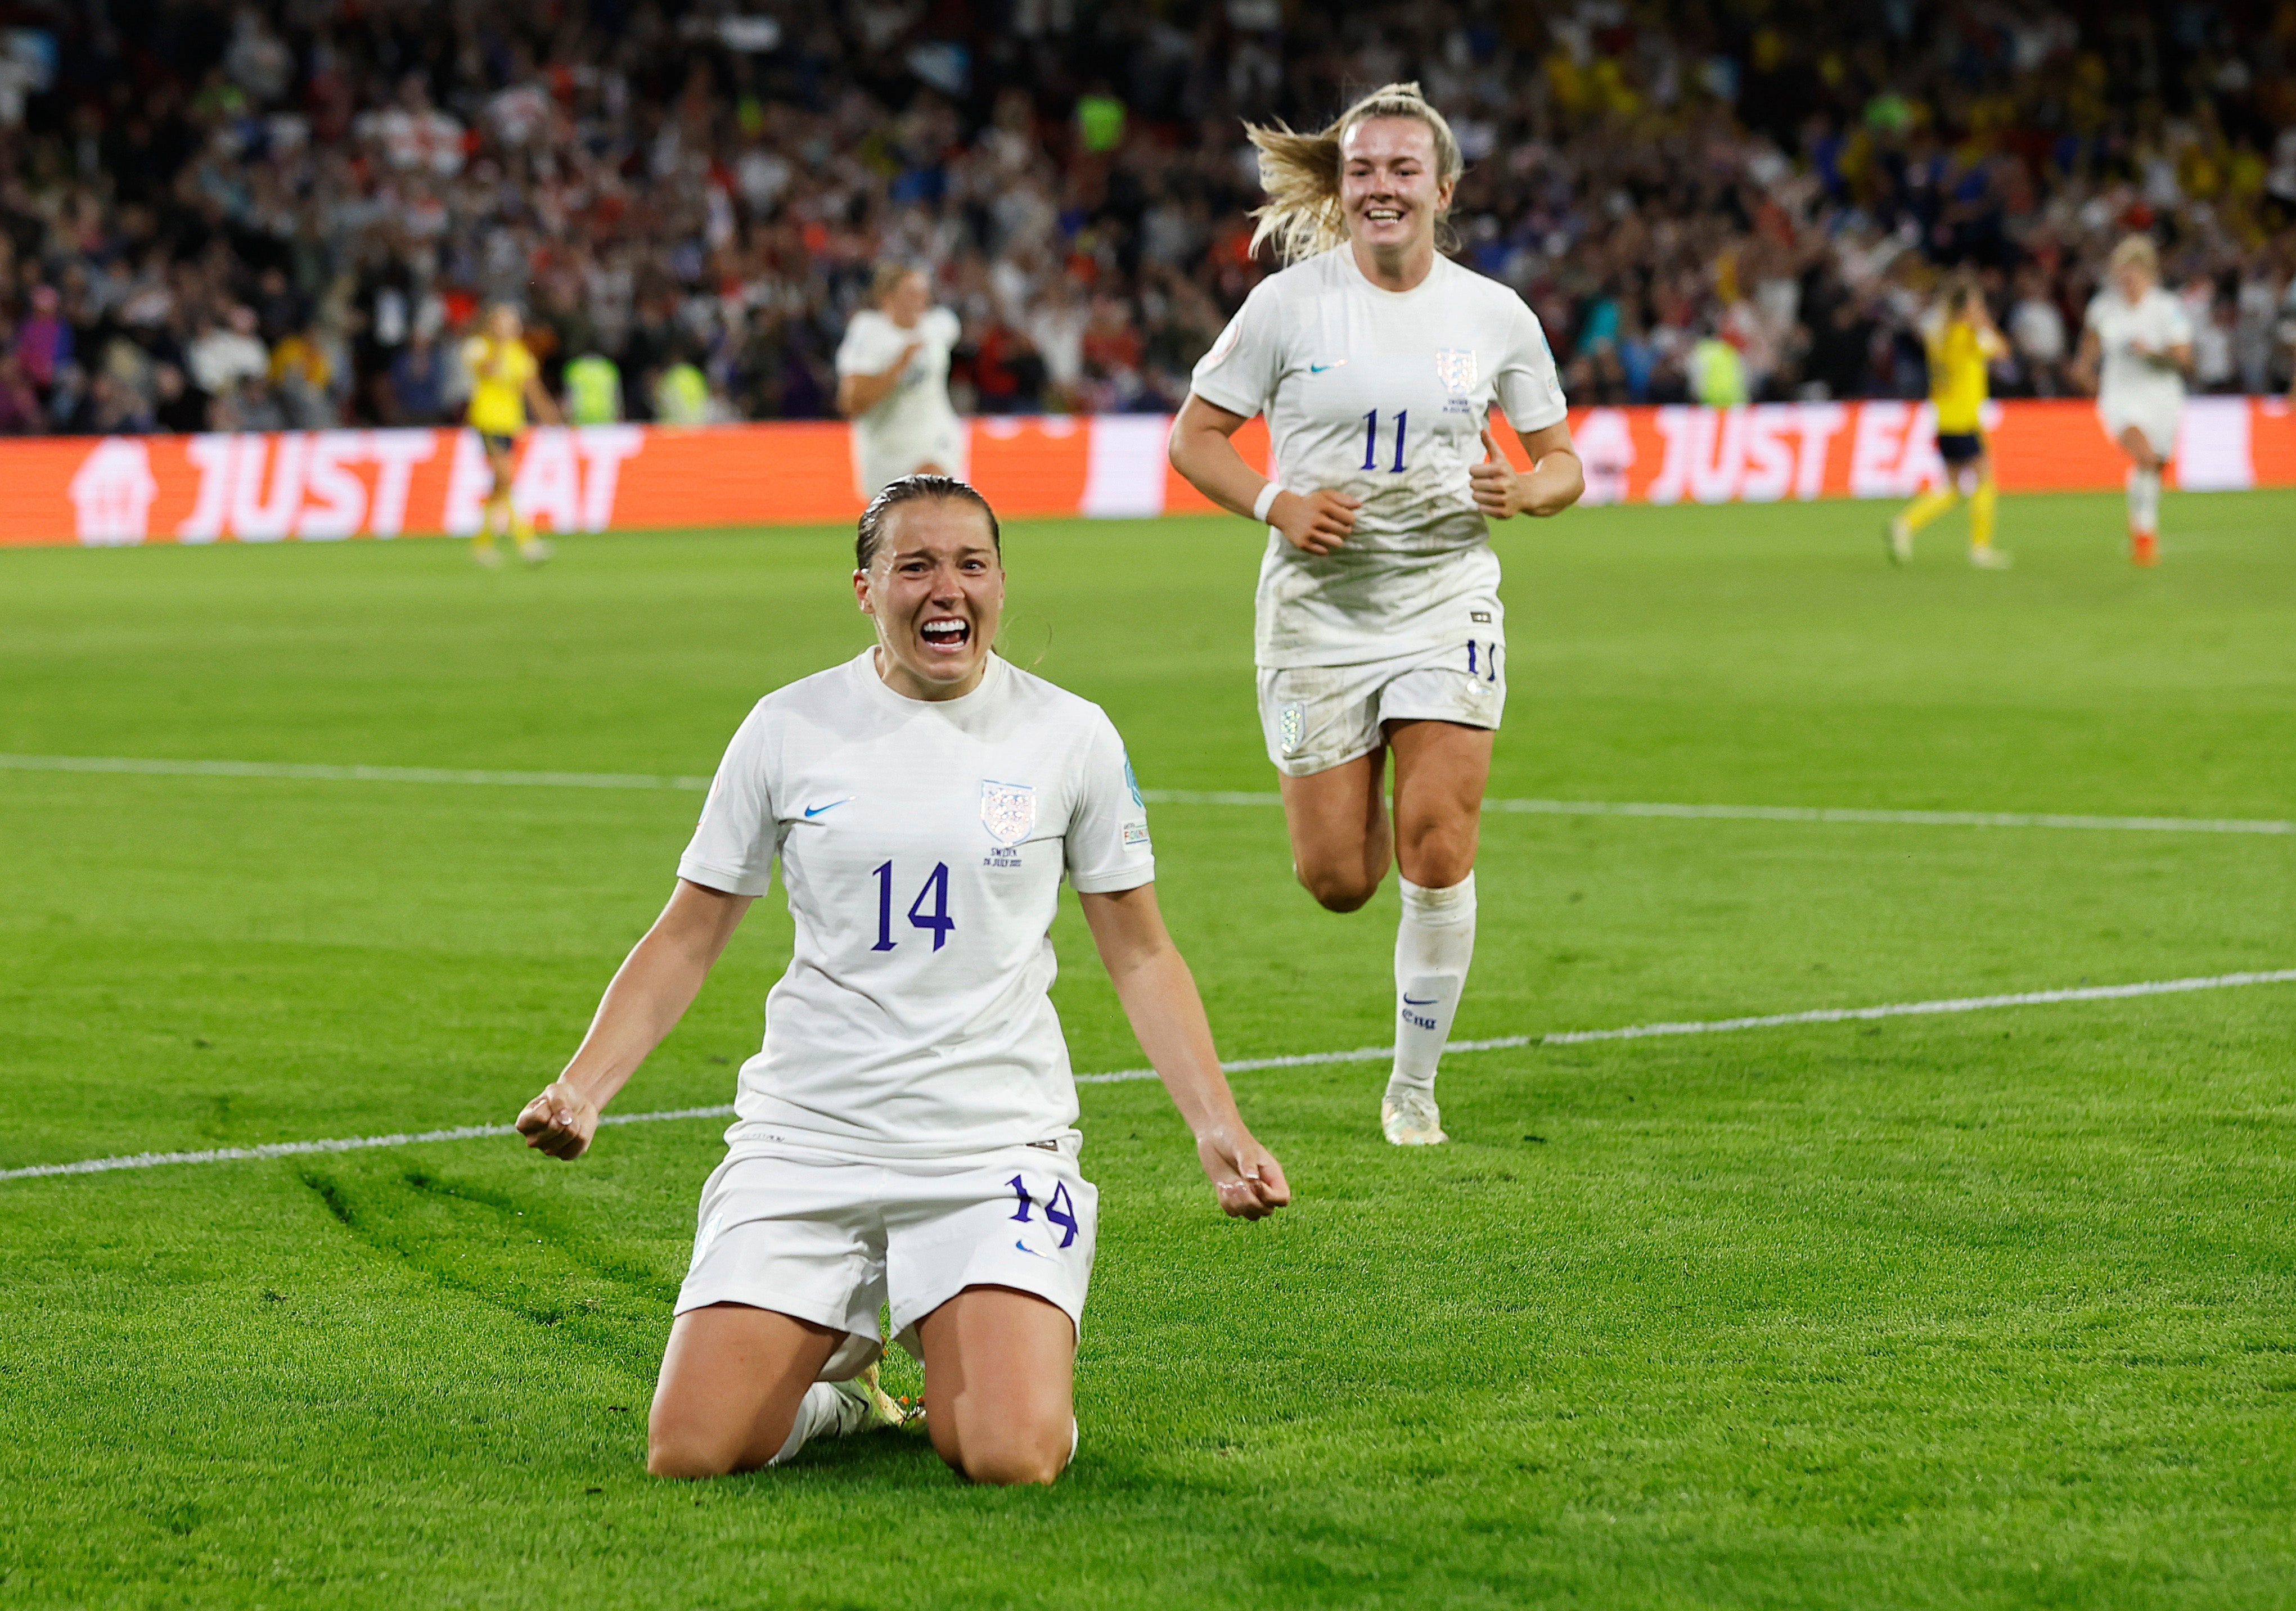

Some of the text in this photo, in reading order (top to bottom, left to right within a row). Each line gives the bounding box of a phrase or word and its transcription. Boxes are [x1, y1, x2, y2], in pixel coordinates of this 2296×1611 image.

[175, 428, 438, 544] JUST
[1359, 408, 1407, 472] 11
[1646, 401, 1848, 504] JUST
[871, 859, 955, 953] 14
[1005, 1174, 1079, 1248] 14
